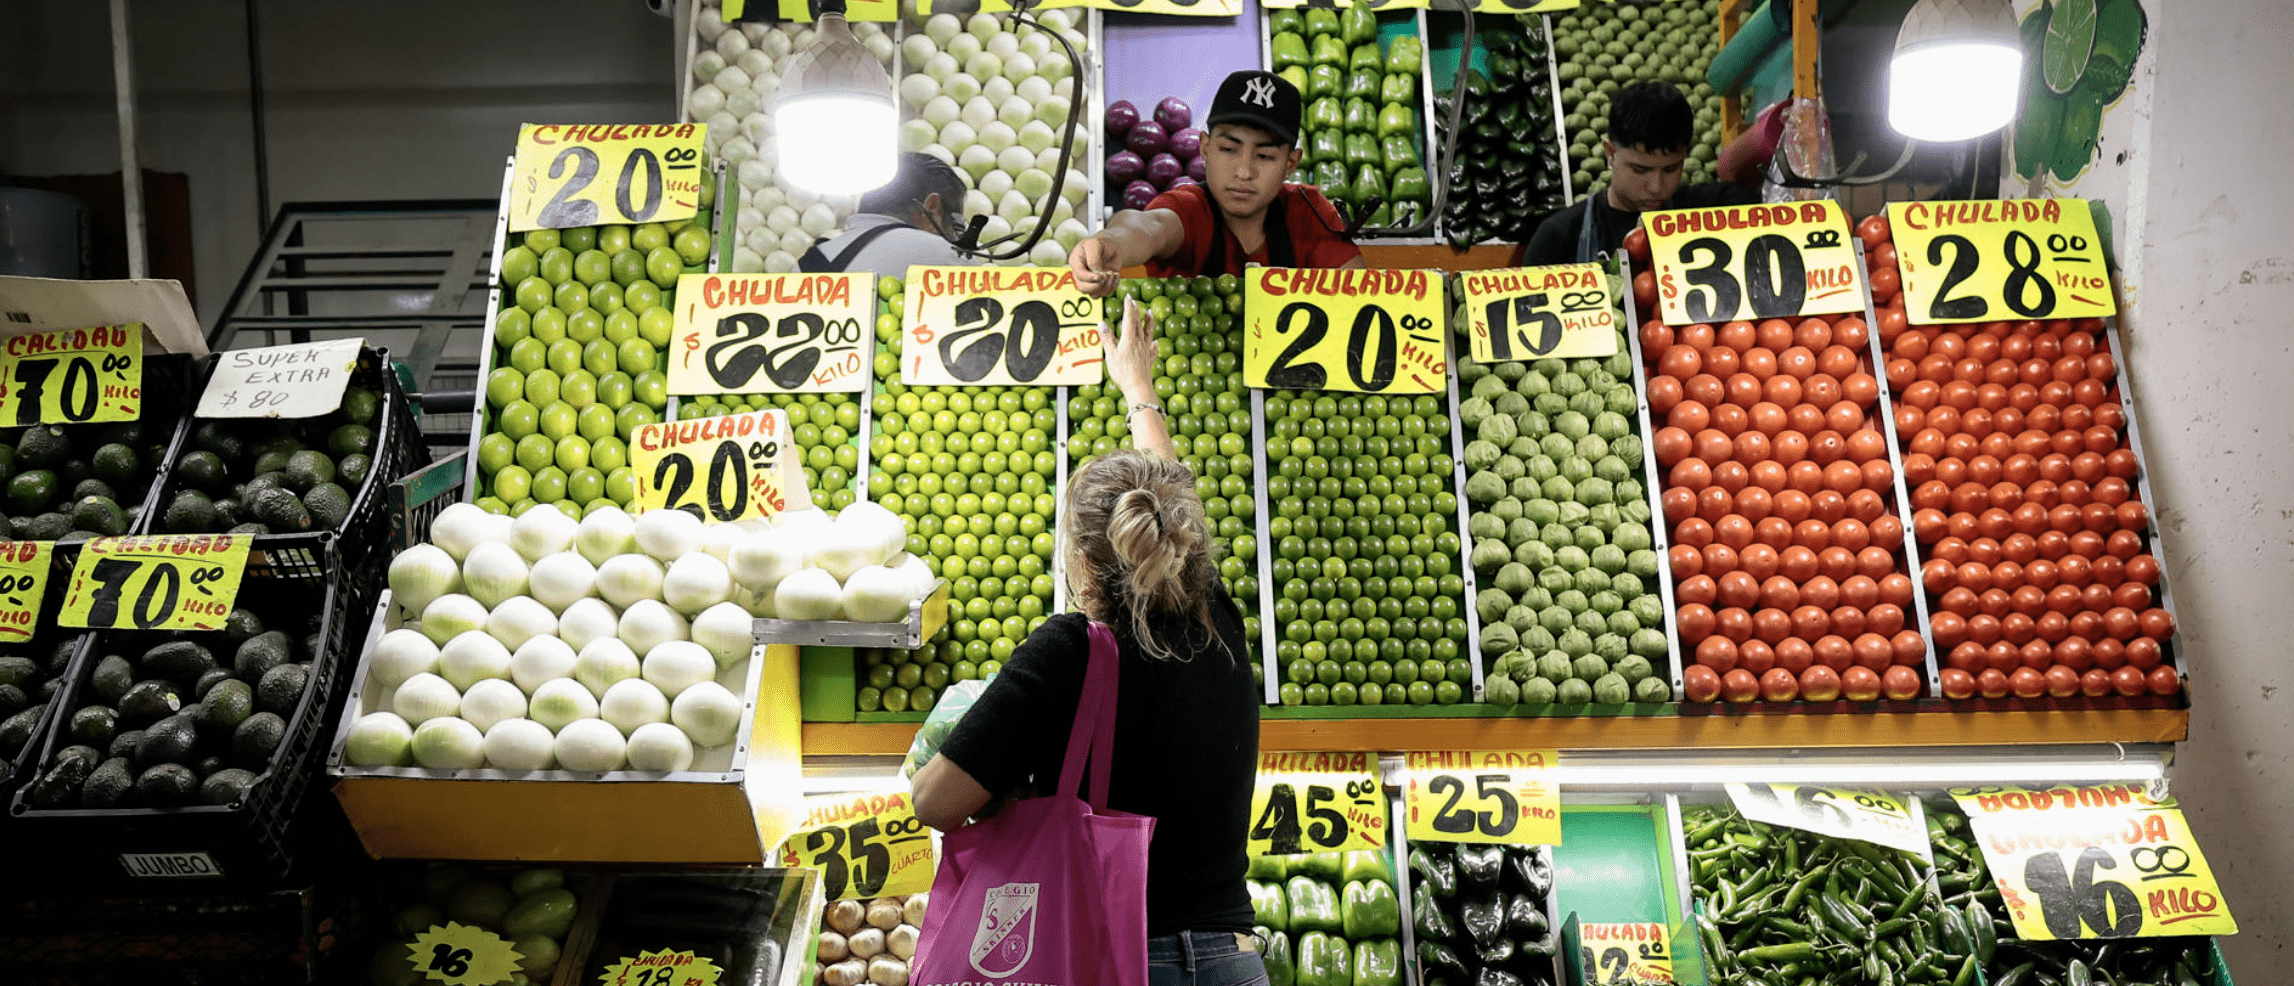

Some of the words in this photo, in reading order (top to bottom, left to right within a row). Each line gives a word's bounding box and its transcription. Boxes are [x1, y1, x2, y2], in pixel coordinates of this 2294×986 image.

[1240, 77, 1276, 108] NY
[533, 124, 696, 145] CHULADA
[537, 146, 662, 229] 20
[1652, 203, 1827, 237] CHULADA
[1905, 199, 2060, 230] CHULADA
[1260, 268, 1428, 301] CHULADA
[1468, 271, 1599, 296] CHULADA
[1678, 234, 1807, 324] 30
[1806, 265, 1853, 291] KILO
[1927, 230, 2057, 319] 28
[2056, 270, 2105, 289] KILO
[703, 276, 850, 308] CHULADA
[1486, 293, 1563, 360] 15
[1564, 311, 1612, 331] KILO
[705, 312, 825, 390] 22
[938, 297, 1060, 383] 20
[1265, 301, 1398, 392] 20
[232, 349, 320, 368] SUPER
[1401, 341, 1446, 375] KILO
[15, 356, 99, 427] 70
[245, 368, 331, 384] EXTRA
[220, 390, 237, 408] $
[249, 390, 289, 409] 80
[640, 412, 776, 451] CHULADA
[751, 473, 785, 512] KILO
[91, 536, 233, 556] CALIDAD
[87, 557, 180, 629] 70
[183, 598, 227, 616] KILO
[0, 610, 31, 625] ILO
[800, 793, 906, 827] HULADA
[1250, 783, 1349, 856] 45
[1347, 807, 1383, 829] KILO
[1429, 774, 1519, 837] 25
[134, 855, 210, 875] JUMBO
[807, 816, 891, 900] 35
[2024, 846, 2143, 939] 16
[2148, 887, 2218, 918] KILO
[428, 943, 474, 977] 16
